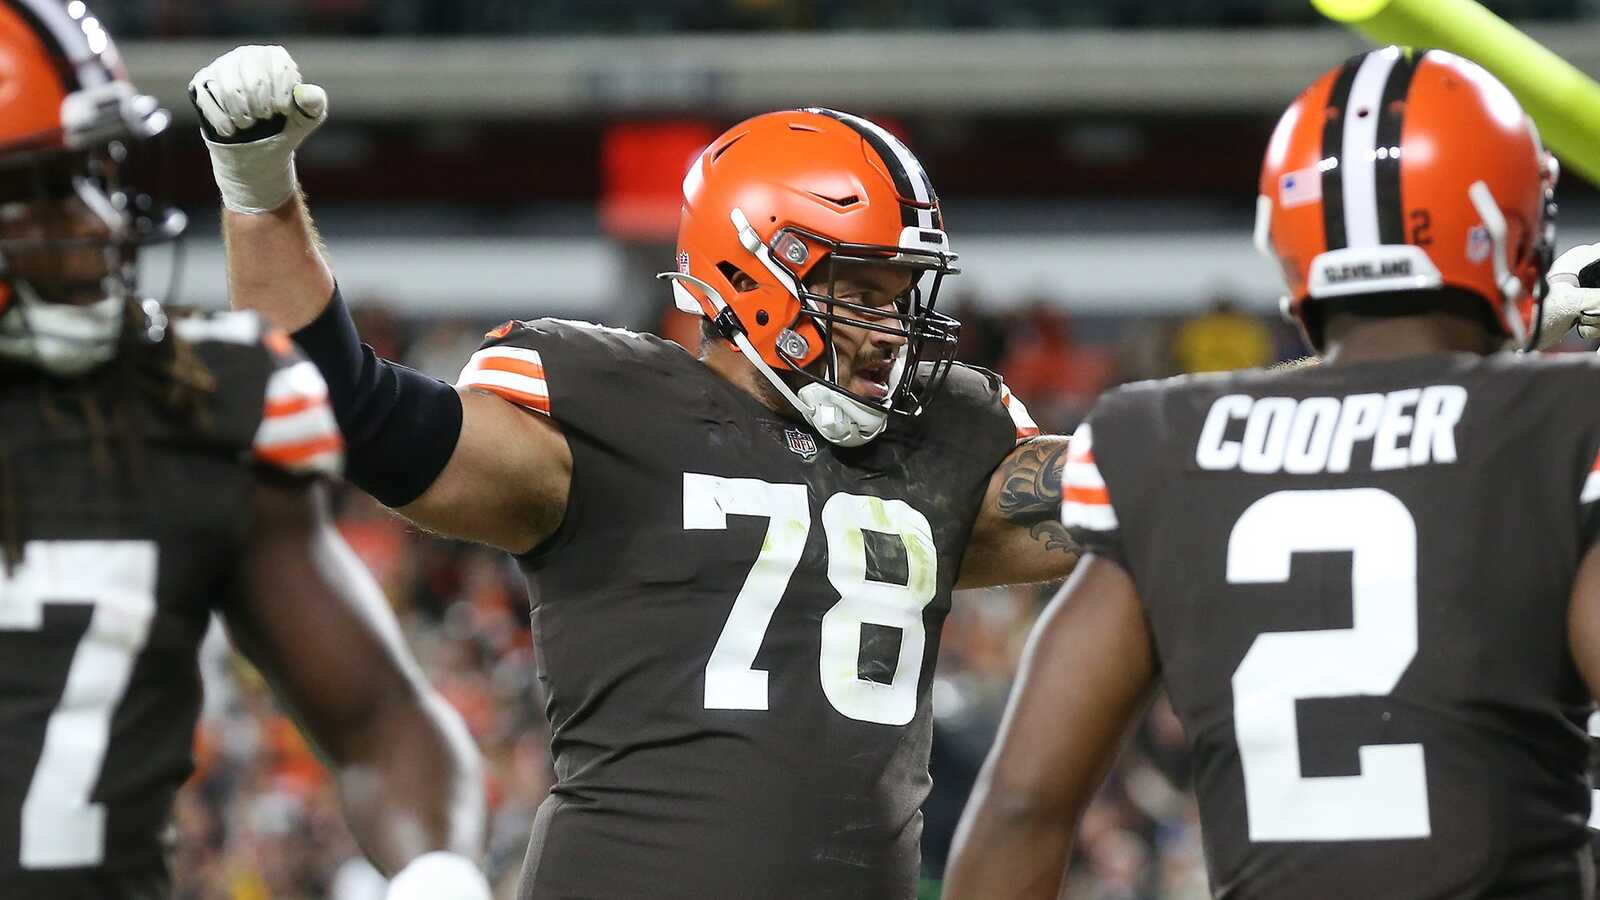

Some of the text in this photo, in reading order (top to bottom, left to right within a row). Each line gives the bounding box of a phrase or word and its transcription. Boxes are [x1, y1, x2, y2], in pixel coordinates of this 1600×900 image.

[1325, 259, 1412, 283] CLEVELAND
[1410, 210, 1433, 246] 2
[1196, 385, 1468, 474] COOPER
[683, 472, 938, 726] 78
[1226, 487, 1431, 842] 2
[0, 540, 158, 869] 7
